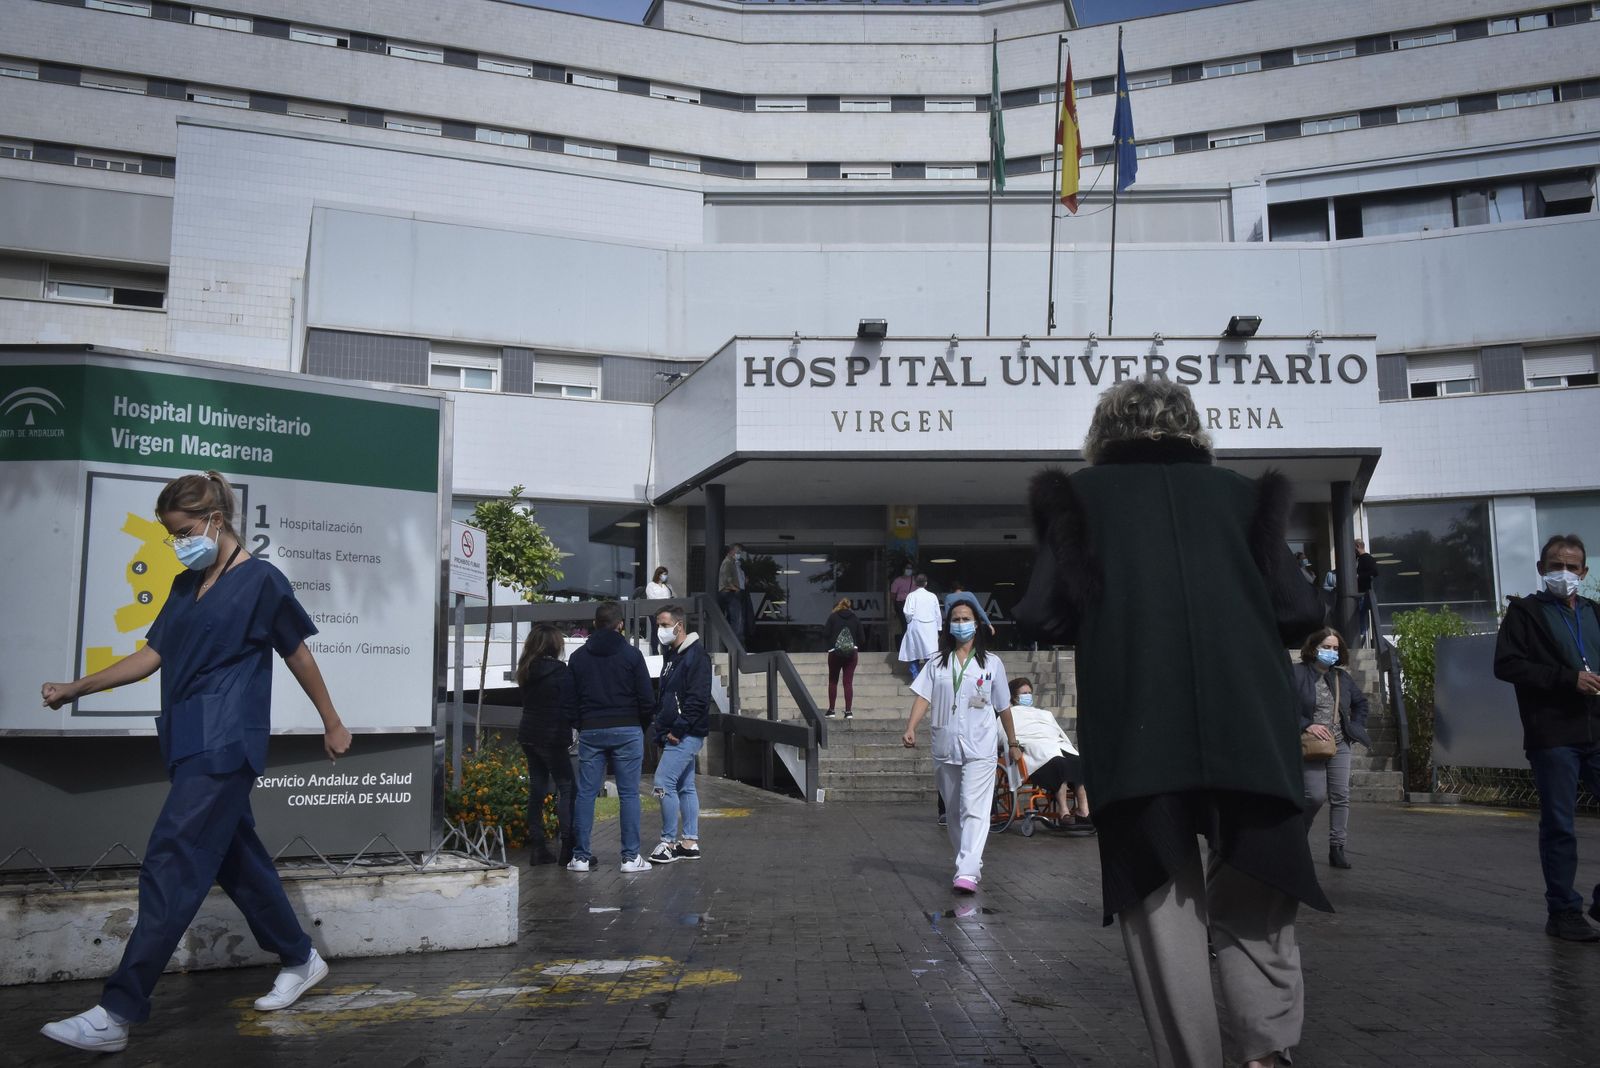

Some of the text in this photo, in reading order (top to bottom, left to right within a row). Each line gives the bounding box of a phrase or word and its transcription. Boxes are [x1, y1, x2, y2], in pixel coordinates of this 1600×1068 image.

[743, 353, 1368, 388] HOSPITAL UNIVERSITARIO
[113, 395, 311, 437] Hospital Universitario
[831, 407, 1284, 432] VIRGEN RENA
[111, 427, 273, 463] Virgen Macarena
[254, 504, 363, 534] 1 Hospitalización
[251, 533, 382, 564] 2 Consultas Externas
[291, 579, 332, 592] gencias
[355, 642, 411, 656] /Gimnasio
[256, 772, 413, 788] Servicio Andaluz de Salud
[287, 791, 412, 806] CONSEJERÍA DE SALUD
